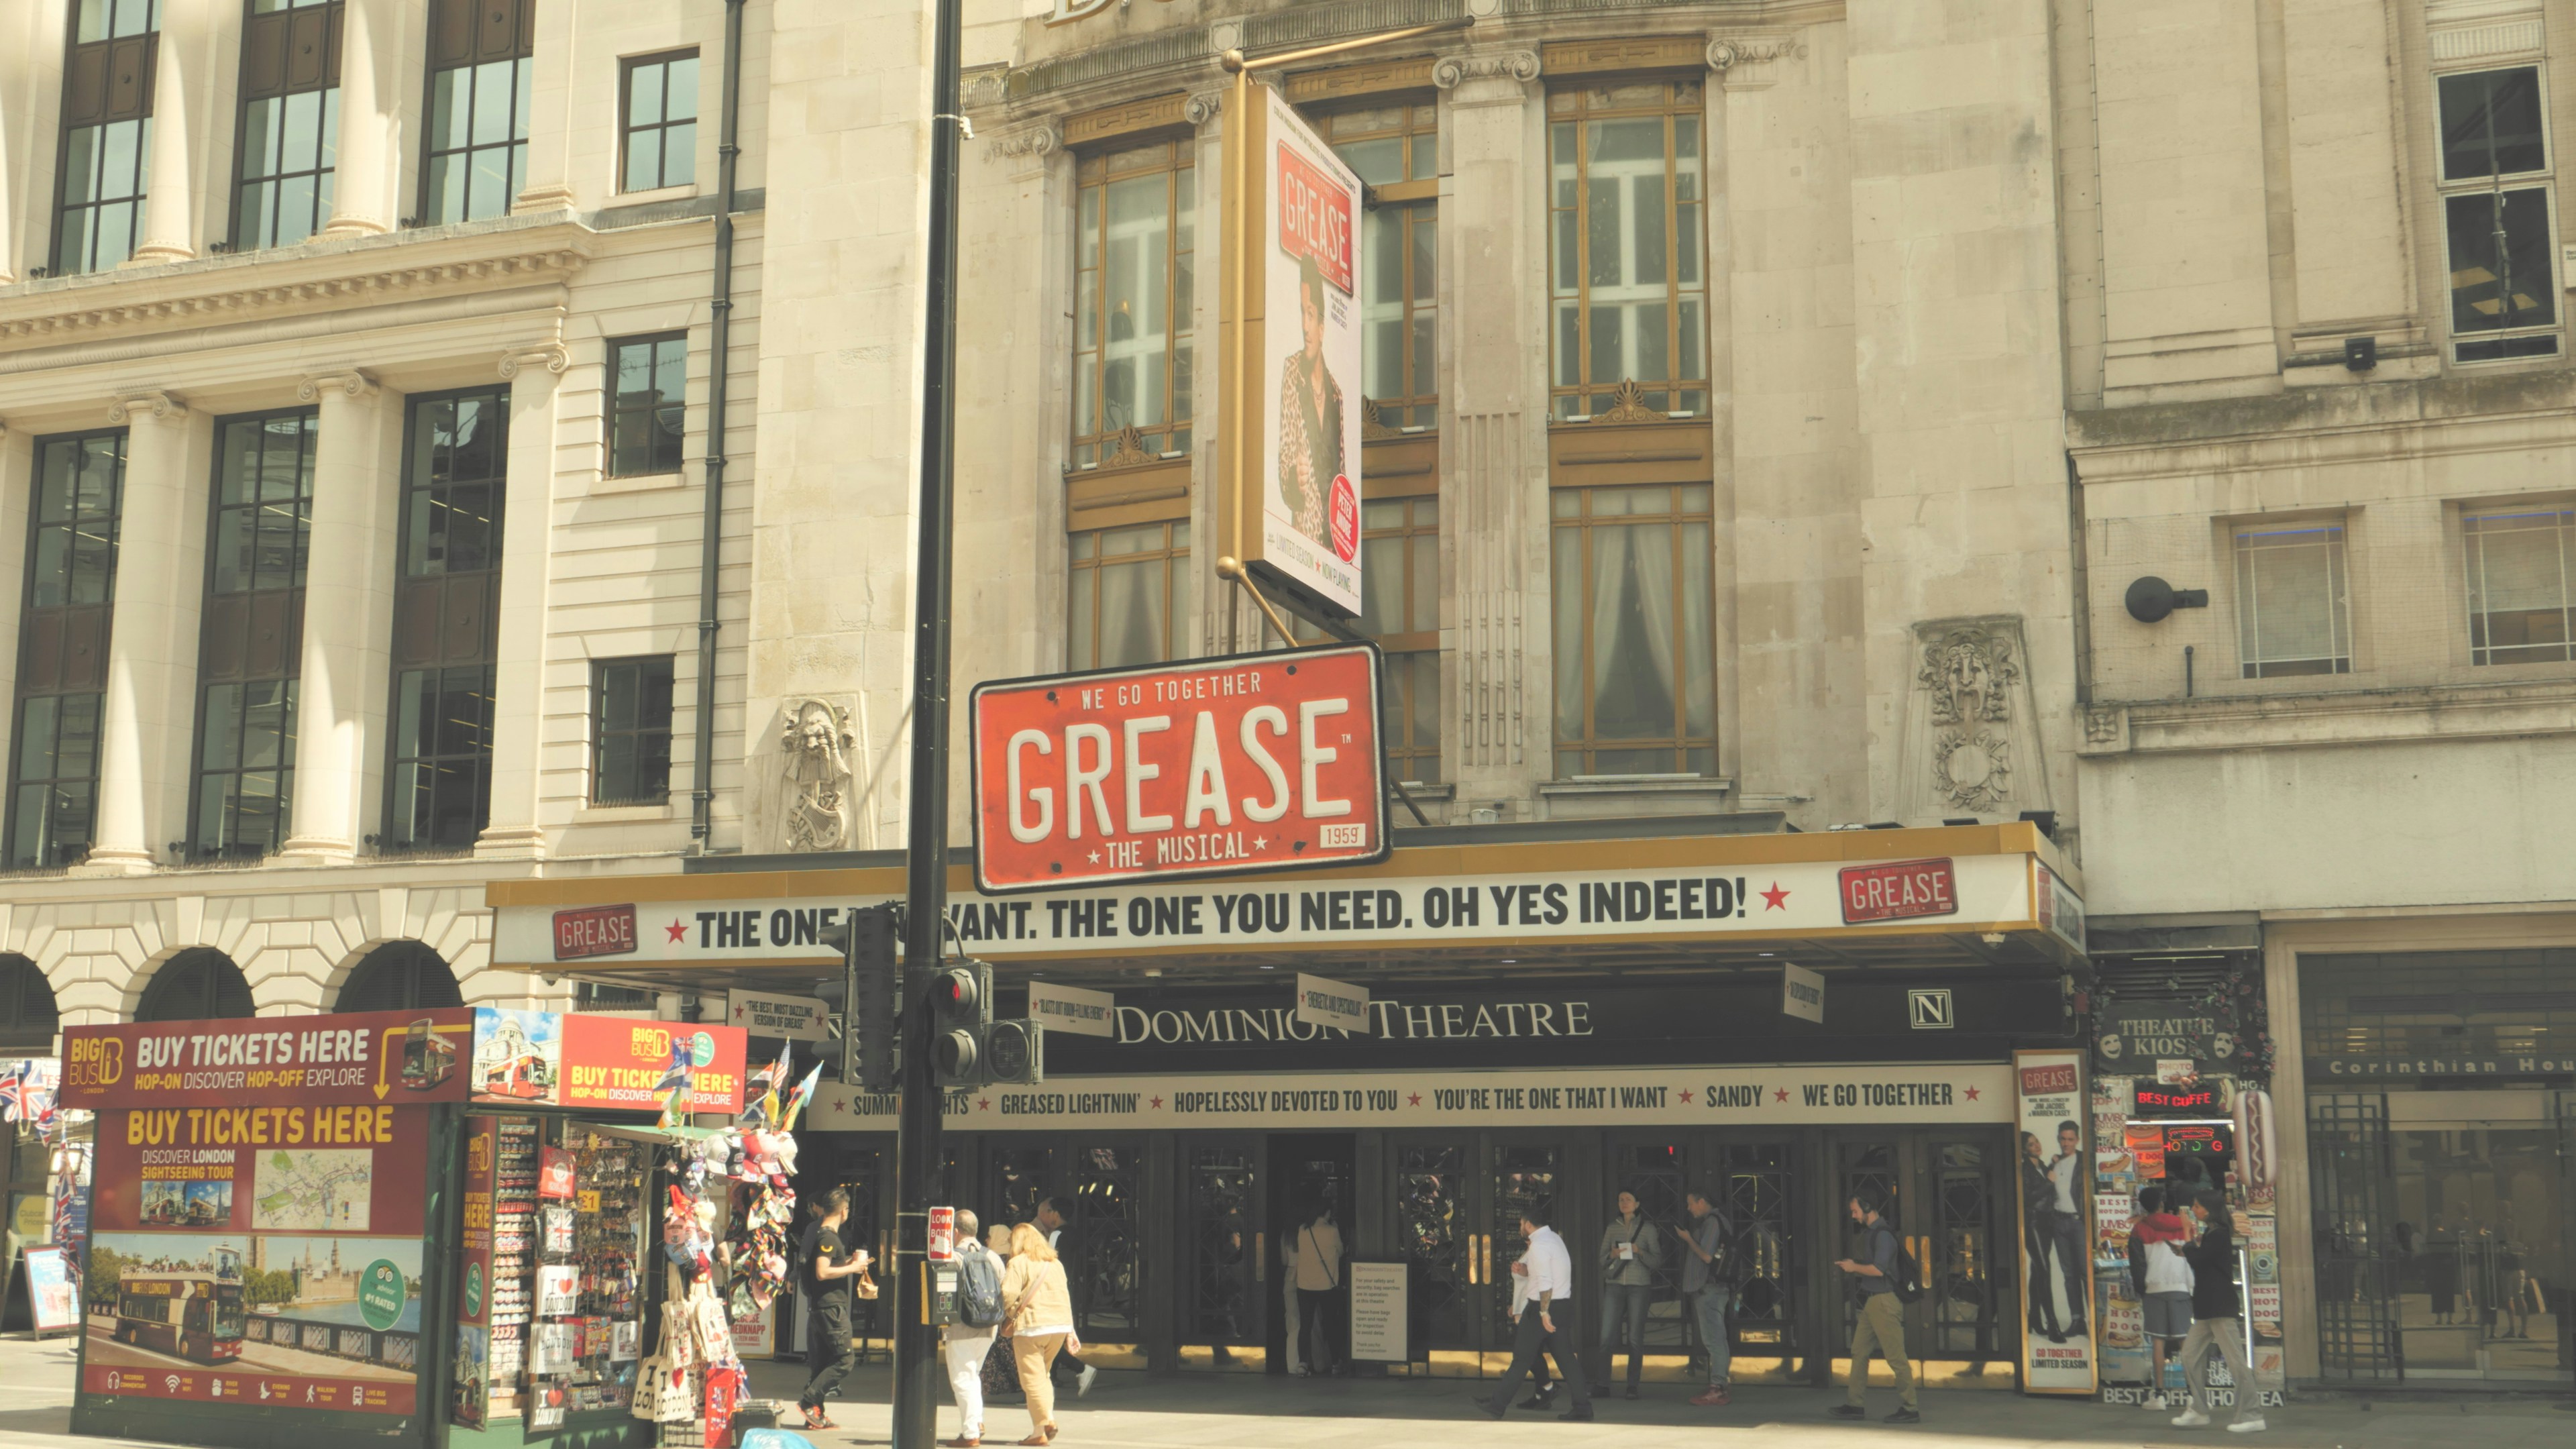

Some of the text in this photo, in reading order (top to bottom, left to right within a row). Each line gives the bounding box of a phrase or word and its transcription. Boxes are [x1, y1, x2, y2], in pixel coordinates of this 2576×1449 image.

[1286, 171, 1348, 271] GREASE
[1338, 490, 1352, 523] PETER
[1336, 509, 1352, 541] ANDRE
[1277, 533, 1295, 559] LIMITED
[1296, 545, 1314, 571] SEASON
[1322, 561, 1333, 582] NOW
[1333, 568, 1351, 593] PLAYING
[1082, 672, 1261, 710] WE GO TOGETHER
[1007, 697, 1352, 844] GREASE
[1106, 826, 1359, 869] THE MUSICAL 1959
[1851, 871, 1948, 910] GREASE
[696, 911, 761, 949] THE
[769, 908, 839, 947] ONE
[1046, 899, 1118, 938] THE
[1128, 896, 1203, 936] ONE
[1212, 893, 1290, 934] YOU
[1300, 887, 1413, 932] NEED.
[1423, 886, 1479, 929] OH
[1489, 882, 1569, 926] YES
[1578, 876, 1746, 924] INDEED!
[1895, 906, 1921, 915] MUSICAL
[561, 915, 631, 948] GREASE
[773, 1003, 813, 1018] MOST DAZZLING
[754, 1014, 784, 1028] VERSION OF
[1367, 1000, 1594, 1040] THEATRE
[632, 1028, 653, 1043] BIG
[70, 1038, 100, 1063] BIG
[137, 1028, 370, 1068] BUY TICKETS HERE
[631, 1042, 653, 1056] BUS
[69, 1063, 98, 1085] BUS
[2157, 1063, 2193, 1071] PHOTO
[2330, 1059, 2496, 1074] Corinthian
[135, 1067, 366, 1091] HOP-ON DISCOVER HOP-OFF EXPLORE
[572, 1065, 608, 1087] BUY
[2026, 1070, 2074, 1089] GREASE
[571, 1087, 607, 1099] HOP-ON
[608, 1088, 653, 1102] DISCOVER
[694, 1093, 732, 1105] EXPLORE
[1175, 1089, 1398, 1114] HOPELESSLY DEVOTED TO YOU
[1434, 1086, 1668, 1110] YOU'RE THE ONE THAT I WANT
[1706, 1085, 1763, 1108] SANDY
[1803, 1083, 1953, 1106] WE GO TOGETHER
[2138, 1092, 2169, 1106] BEST
[1001, 1092, 1141, 1116] GREASED LIGHTNIN'
[2045, 1102, 2065, 1110] JACOBS
[127, 1106, 394, 1145] BUY TICKETS HERE
[142, 1149, 235, 1165] DISCOVER LONDON
[142, 1165, 235, 1180] SIGHTSEEING TOUR
[464, 1203, 490, 1229] HERE
[931, 1214, 952, 1224] LOOK
[2099, 1219, 2132, 1230] JUMBO
[930, 1228, 951, 1238] BOTH
[2250, 1242, 2275, 1250] DOG
[148, 1283, 171, 1295] LONDON
[365, 1293, 396, 1311] #1 RATED
[544, 1295, 574, 1313] LONDON
[2253, 1298, 2278, 1306] HOT
[2110, 1309, 2139, 1319] HOT
[2254, 1309, 2279, 1318] DOG
[730, 1325, 766, 1335] REDKNAPP
[2110, 1322, 2140, 1331] DOG
[541, 1339, 573, 1351] LONDON
[2036, 1348, 2083, 1358] GO TOGETHER
[2031, 1358, 2088, 1369] LIMITED SEASON
[364, 1398, 387, 1406] TRACKING
[655, 1394, 689, 1415] LONDON
[2104, 1388, 2145, 1404] BEST
[534, 1407, 565, 1426] LONDON
